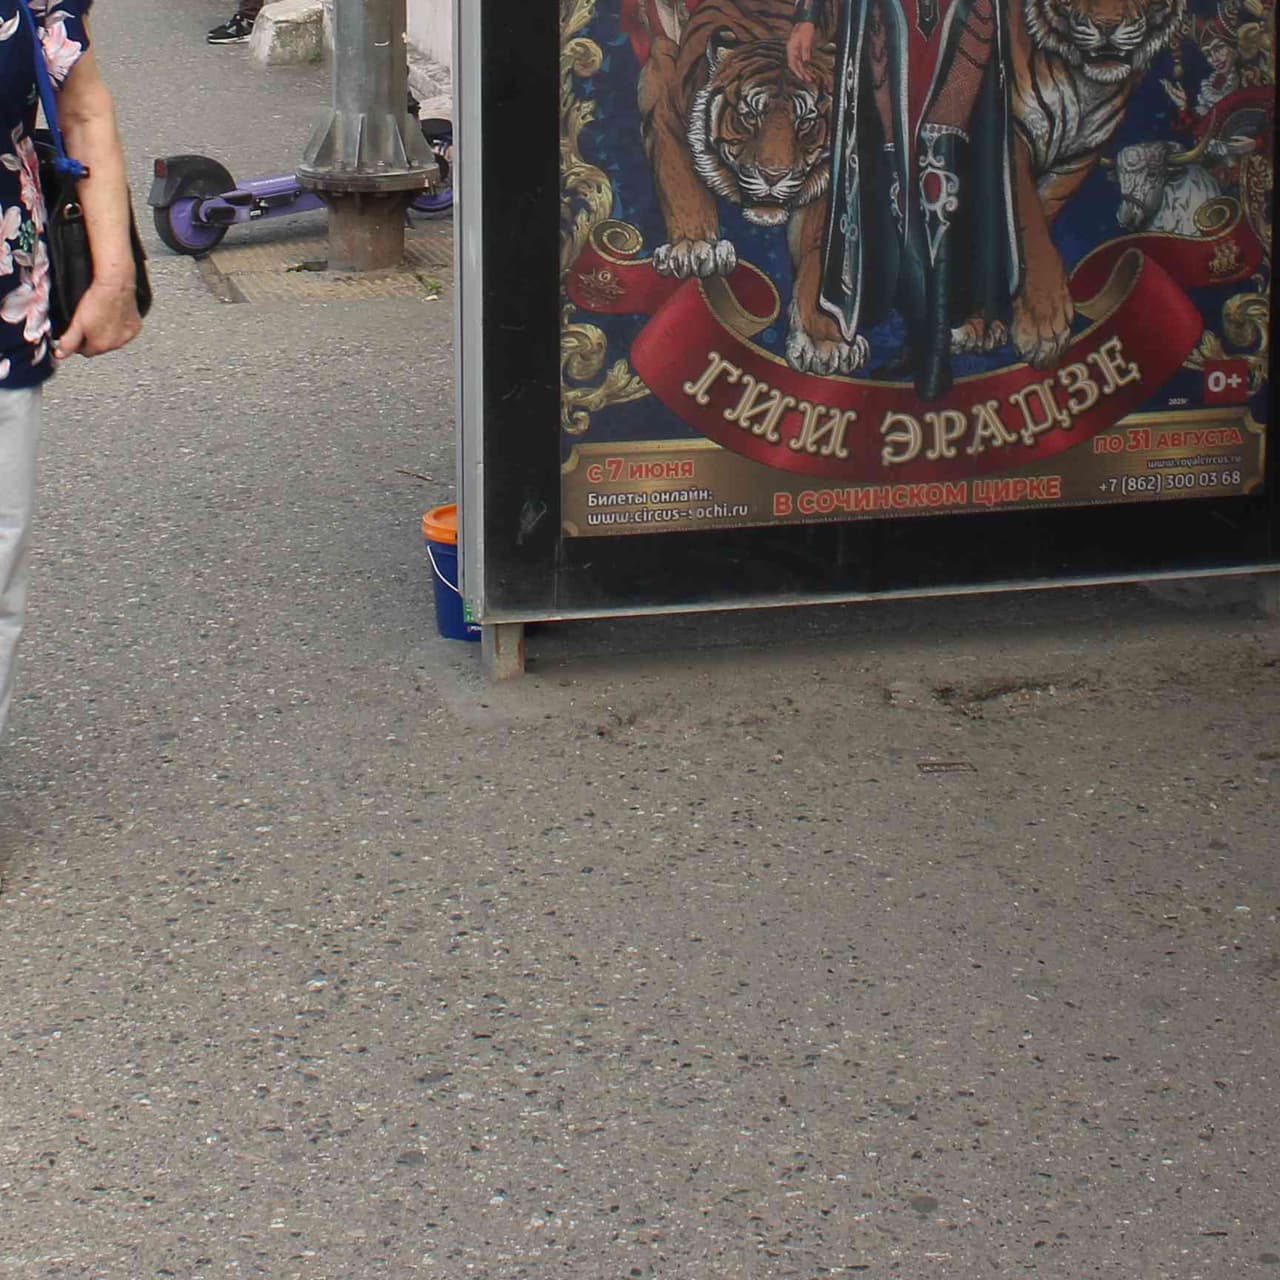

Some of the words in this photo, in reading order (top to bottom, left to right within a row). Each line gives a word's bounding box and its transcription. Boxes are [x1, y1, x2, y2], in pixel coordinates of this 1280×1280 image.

[1208, 371, 1242, 393] 0+
[683, 350, 856, 458] ГИИ
[880, 336, 1140, 466] ЭРАДЗЕ
[1093, 435, 1124, 454] ПО
[1126, 428, 1151, 452] 31
[1156, 427, 1242, 449] АВГУСТА
[606, 458, 624, 481] 7
[1099, 480, 1118, 493] +7
[1122, 474, 1161, 495] (862)
[1167, 475, 1194, 489] 300
[1199, 472, 1217, 486] 03
[1222, 471, 1241, 485] 68
[588, 492, 647, 507] Билеты
[651, 487, 713, 504] онлайн:
[773, 492, 793, 516] В
[797, 481, 967, 514] СОЧИНСКОМ
[972, 475, 1062, 506] ЦИРКЕ
